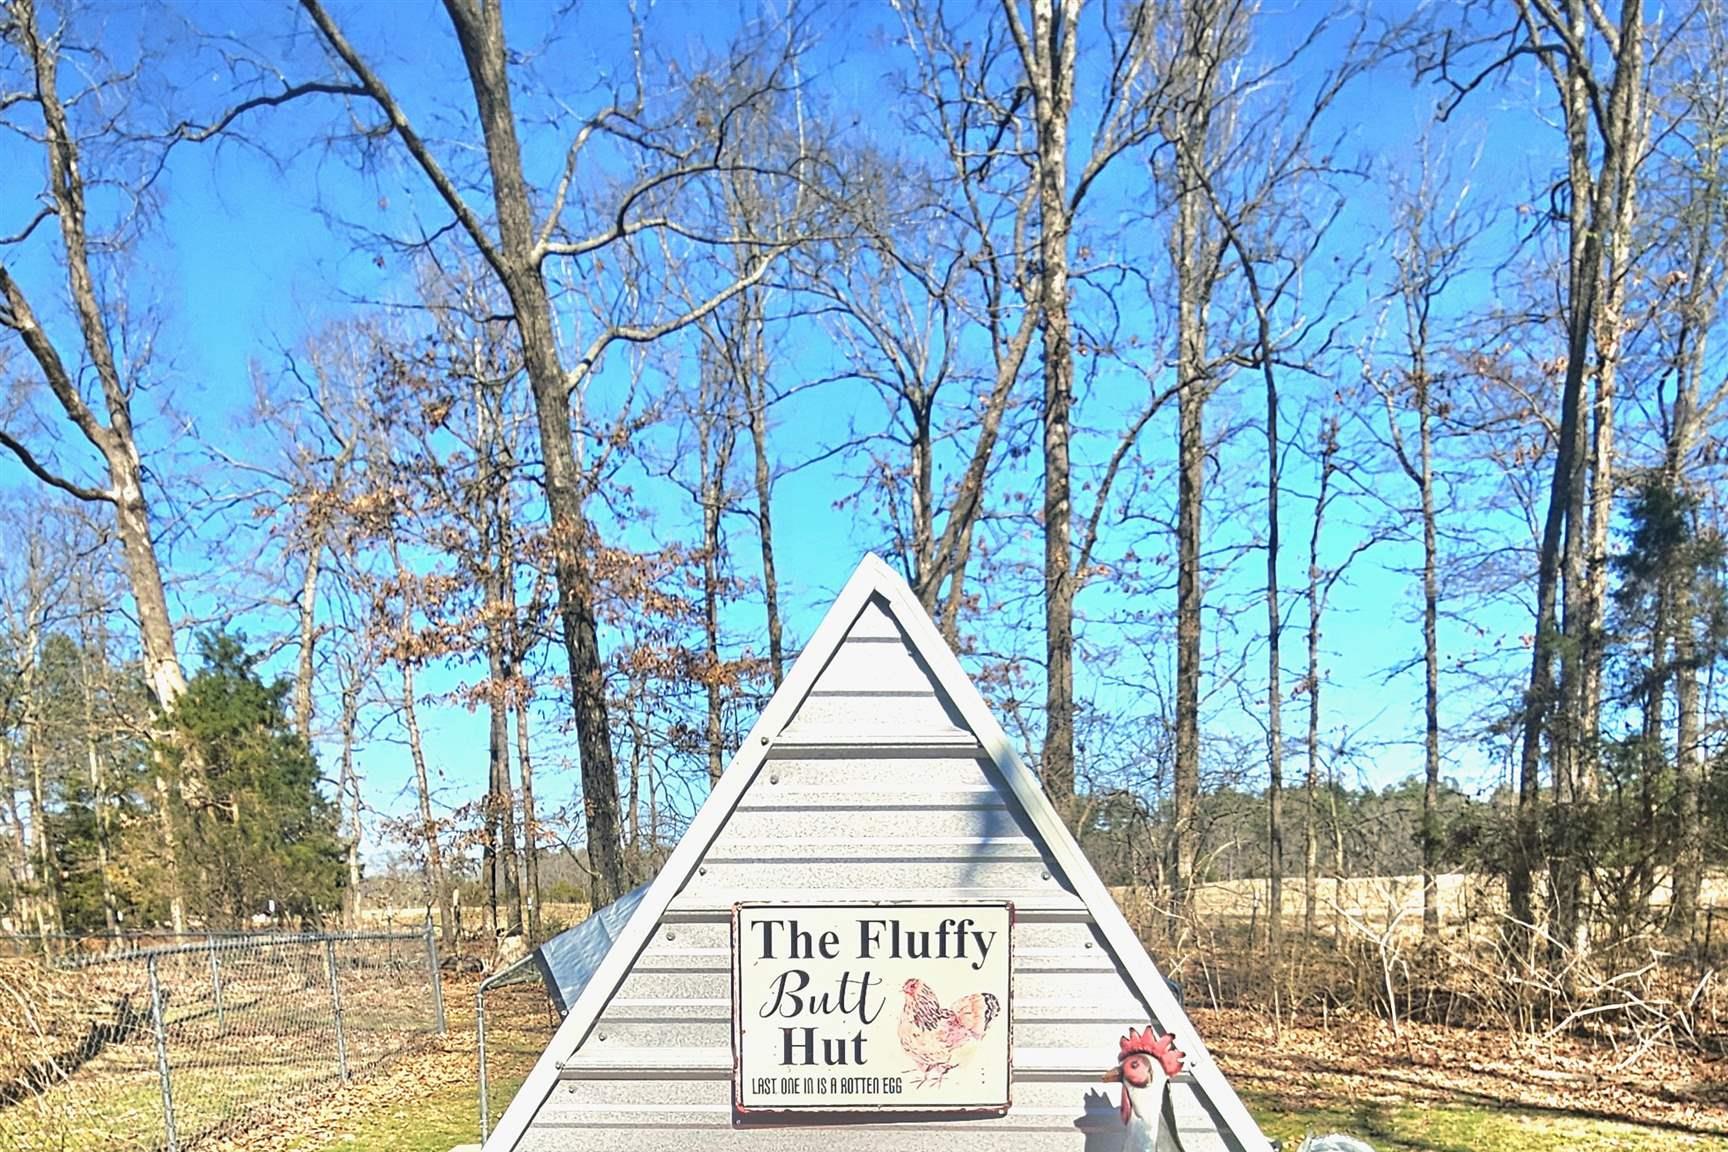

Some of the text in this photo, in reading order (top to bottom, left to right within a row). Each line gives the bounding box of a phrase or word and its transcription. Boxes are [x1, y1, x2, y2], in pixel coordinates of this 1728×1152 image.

[750, 918, 998, 971] The Fluffy
[758, 969, 887, 1026] Butt
[778, 1026, 868, 1066] Hut
[751, 1077, 902, 1095] LAST ONE IN IS A ROTTEN EGG
